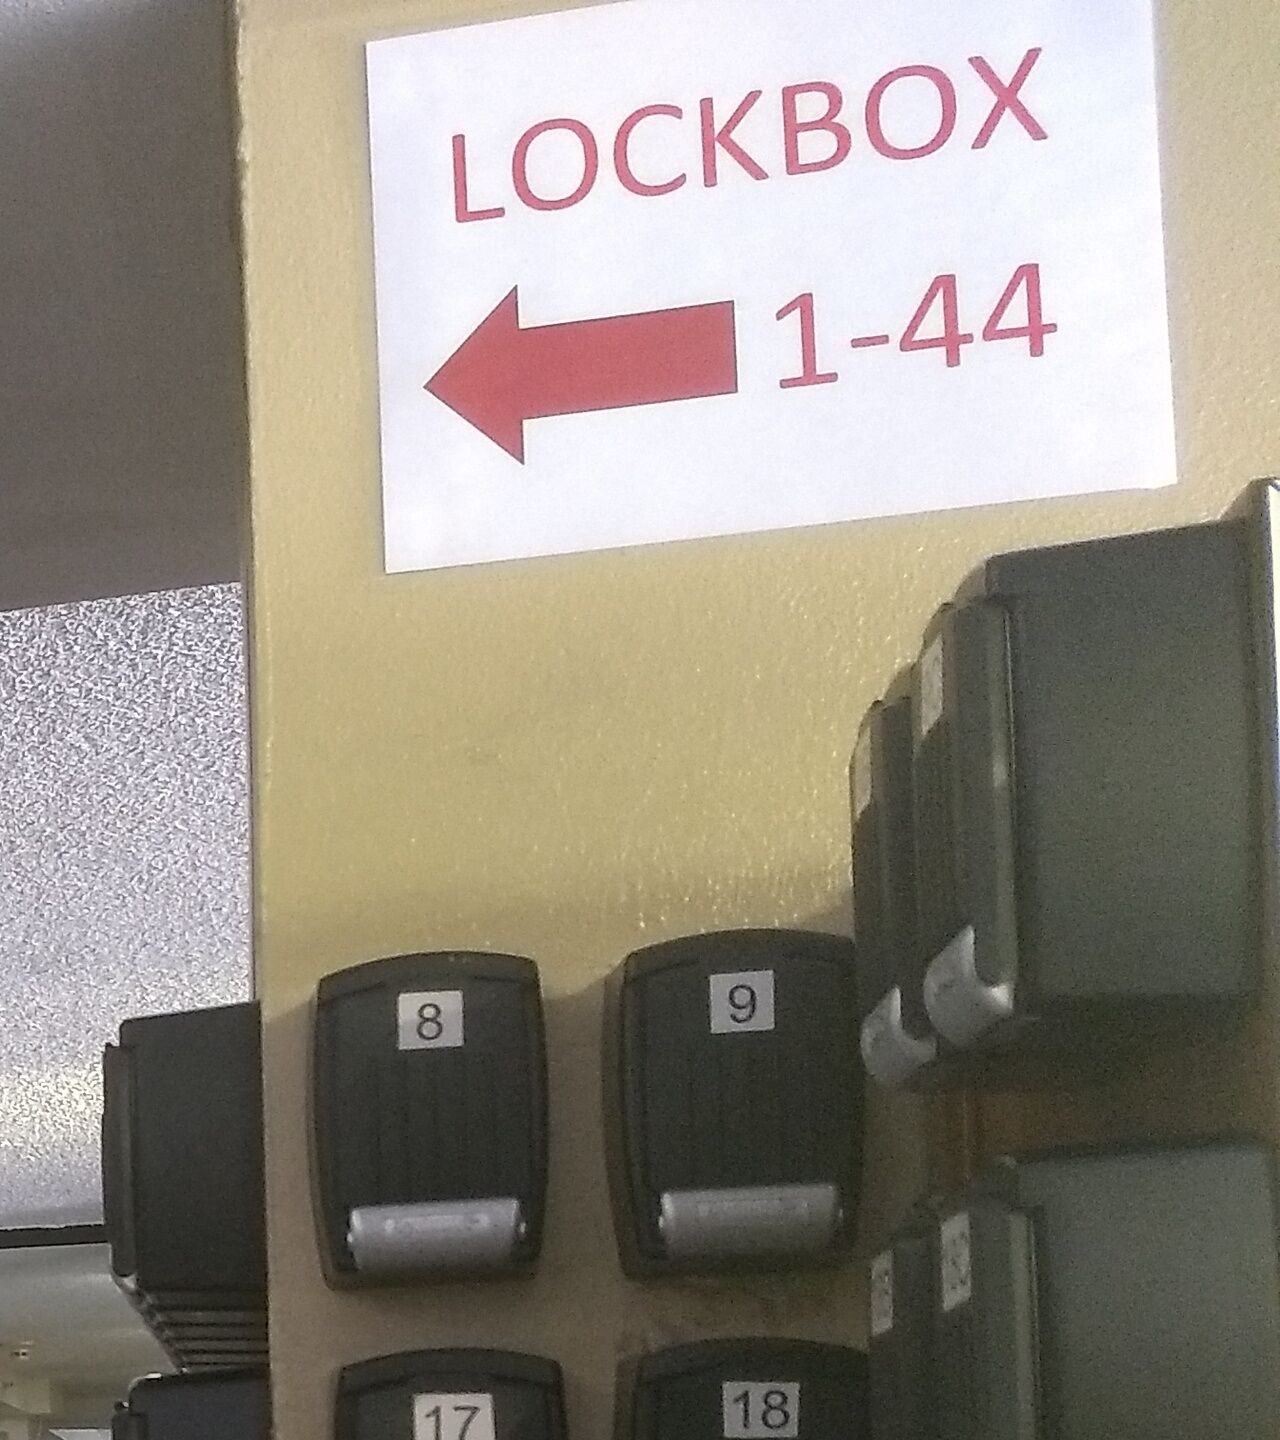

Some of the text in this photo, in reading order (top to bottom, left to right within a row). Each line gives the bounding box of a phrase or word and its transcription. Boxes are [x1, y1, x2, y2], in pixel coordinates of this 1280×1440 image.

[451, 47, 1048, 223] LOCKBOX
[774, 262, 1057, 389] 1-44
[415, 1002, 444, 1042] 8
[728, 983, 757, 1024] 9
[733, 1389, 791, 1430] 18
